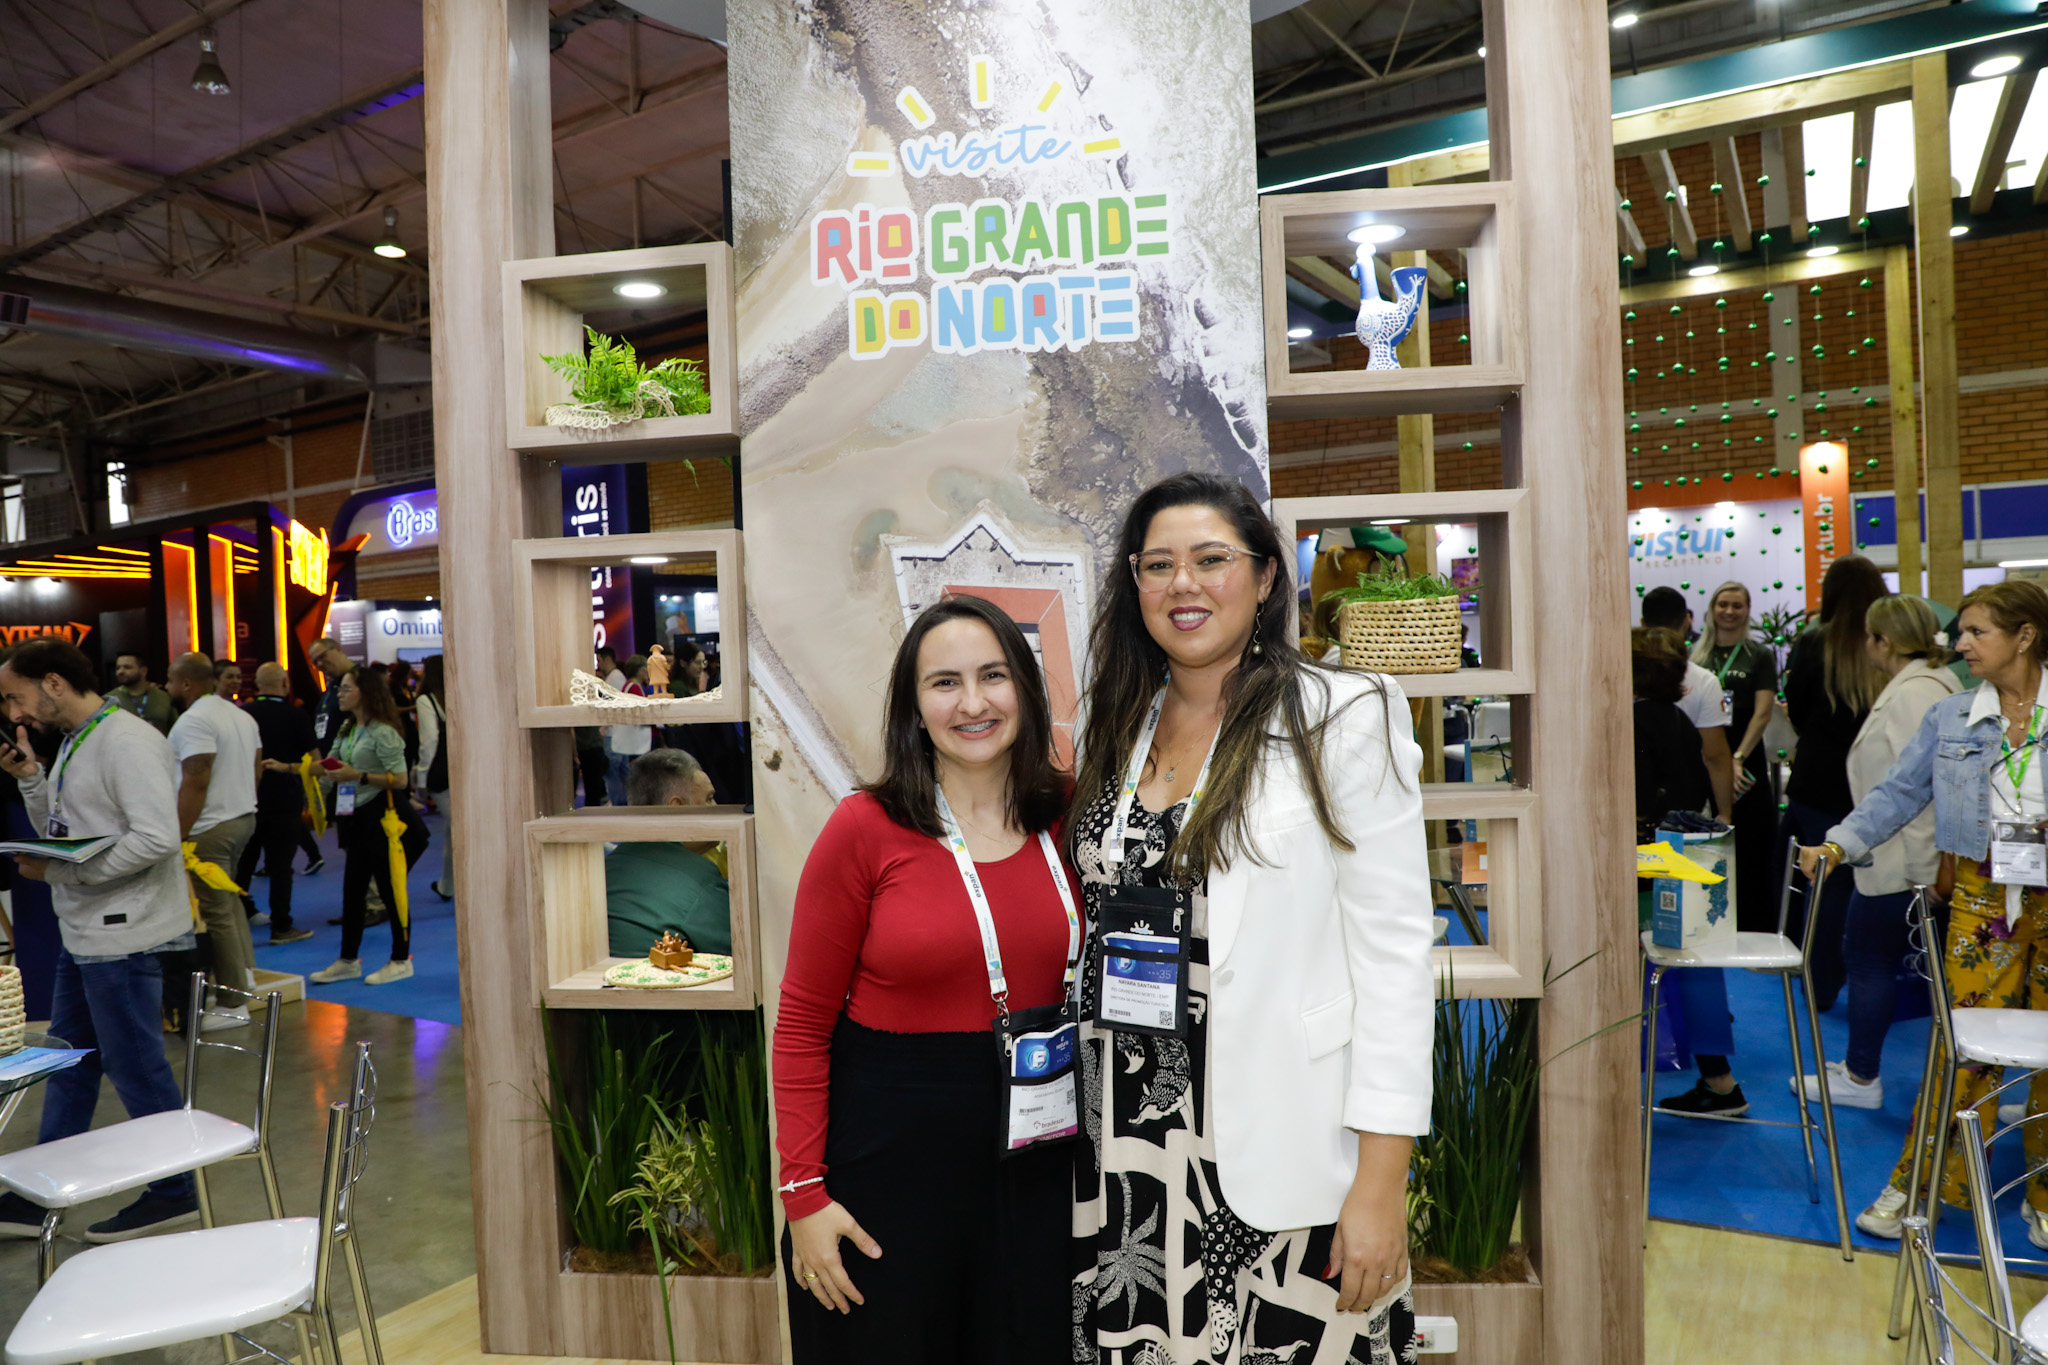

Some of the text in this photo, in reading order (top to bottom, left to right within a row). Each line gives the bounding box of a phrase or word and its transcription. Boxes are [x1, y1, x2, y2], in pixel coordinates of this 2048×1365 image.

[906, 124, 1072, 172] visite
[931, 193, 1170, 274] GRANDE
[856, 275, 1133, 353] DO NORTE
[386, 500, 438, 548] Bras
[968, 873, 982, 898] expan
[1051, 865, 1064, 890] expan
[1118, 979, 1160, 990] NAYARA SANTANA
[1159, 969, 1171, 980] 35
[1041, 1118, 1065, 1129] bradesco
